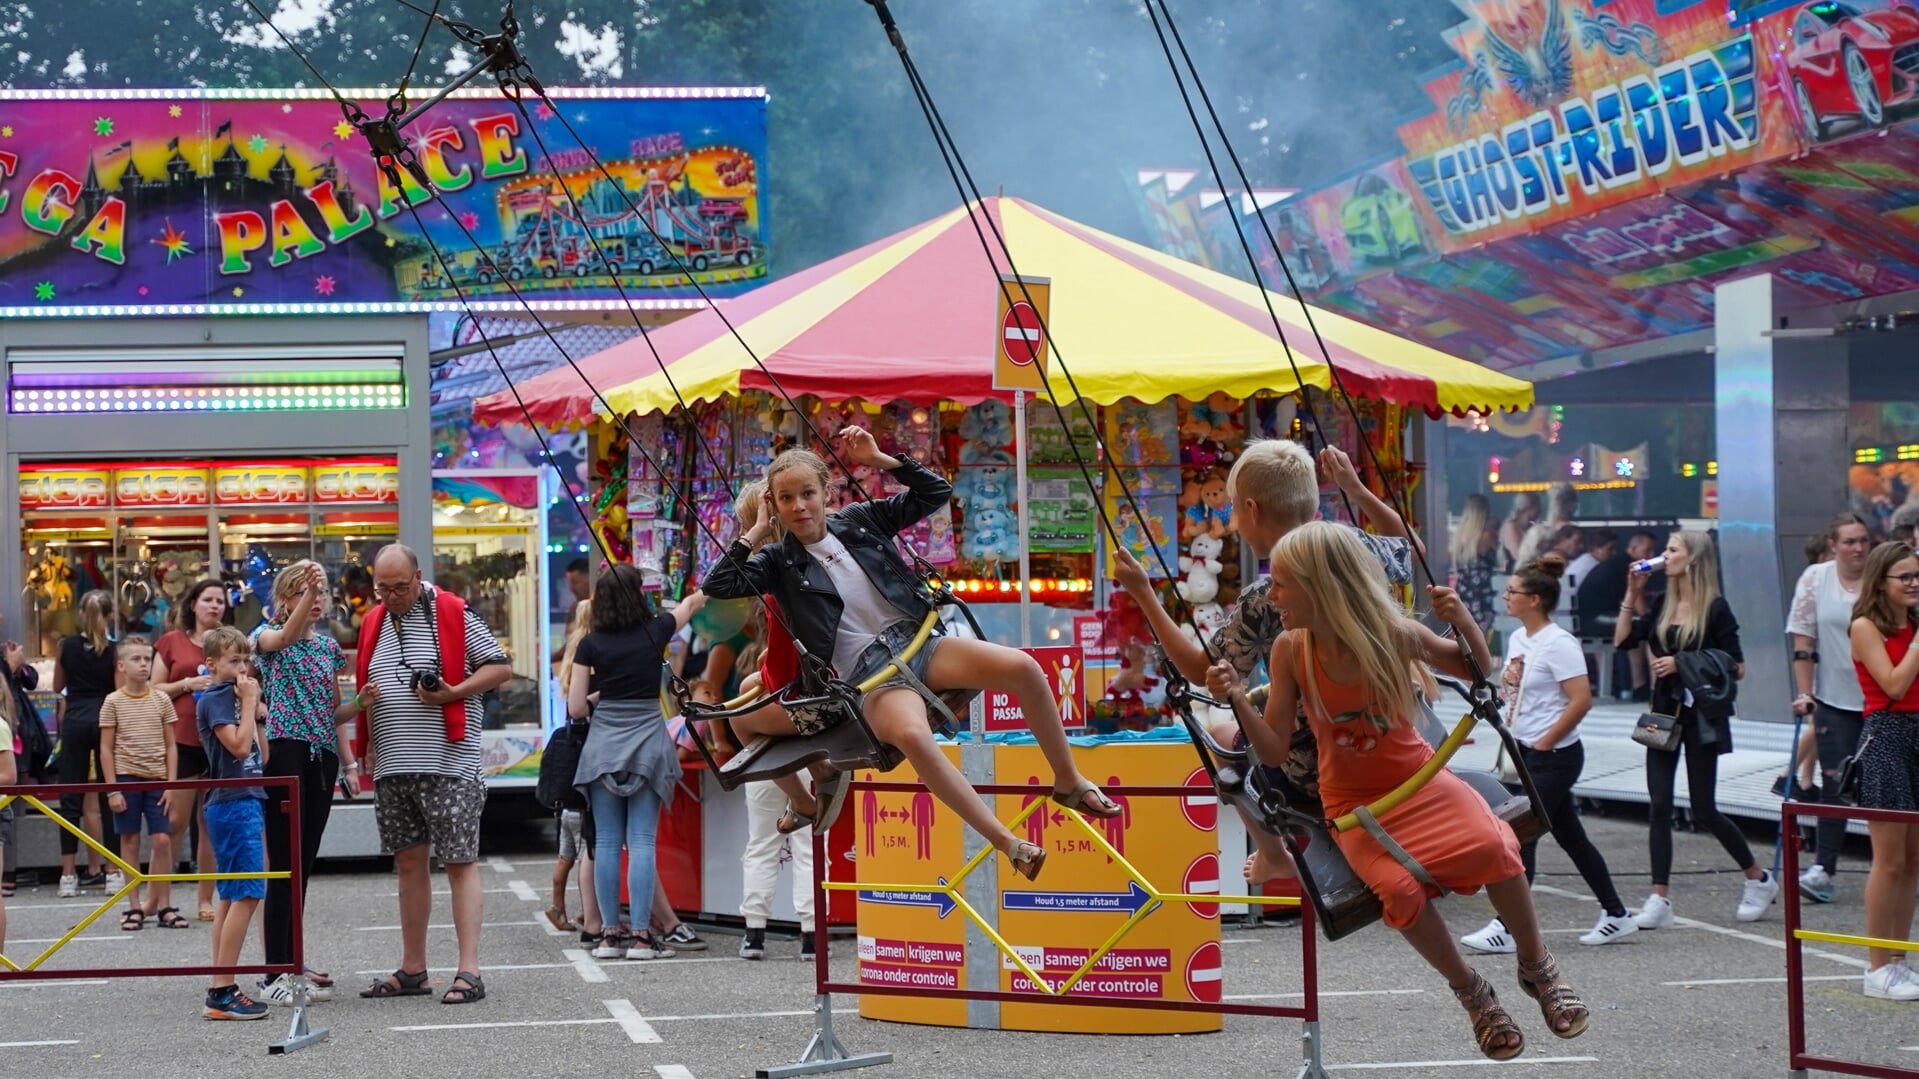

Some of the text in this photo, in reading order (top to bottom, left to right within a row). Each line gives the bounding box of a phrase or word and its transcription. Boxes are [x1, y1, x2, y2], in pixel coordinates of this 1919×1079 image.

[214, 113, 527, 274] PALACE
[993, 694, 1008, 707] NO
[993, 707, 1024, 720] PASSA
[882, 835, 895, 848] 1,5
[1055, 840, 1074, 854] 1,5
[1034, 896, 1119, 907] Houd 1,5 meter afstand
[876, 945, 905, 958] samen
[908, 945, 943, 963] krijgen
[945, 950, 962, 962] we
[1045, 954, 1088, 967] samen
[1145, 957, 1167, 967] we
[883, 968, 911, 983] onder
[911, 972, 955, 986] controle
[1013, 978, 1055, 990] coroa
[1098, 979, 1158, 992] controle
